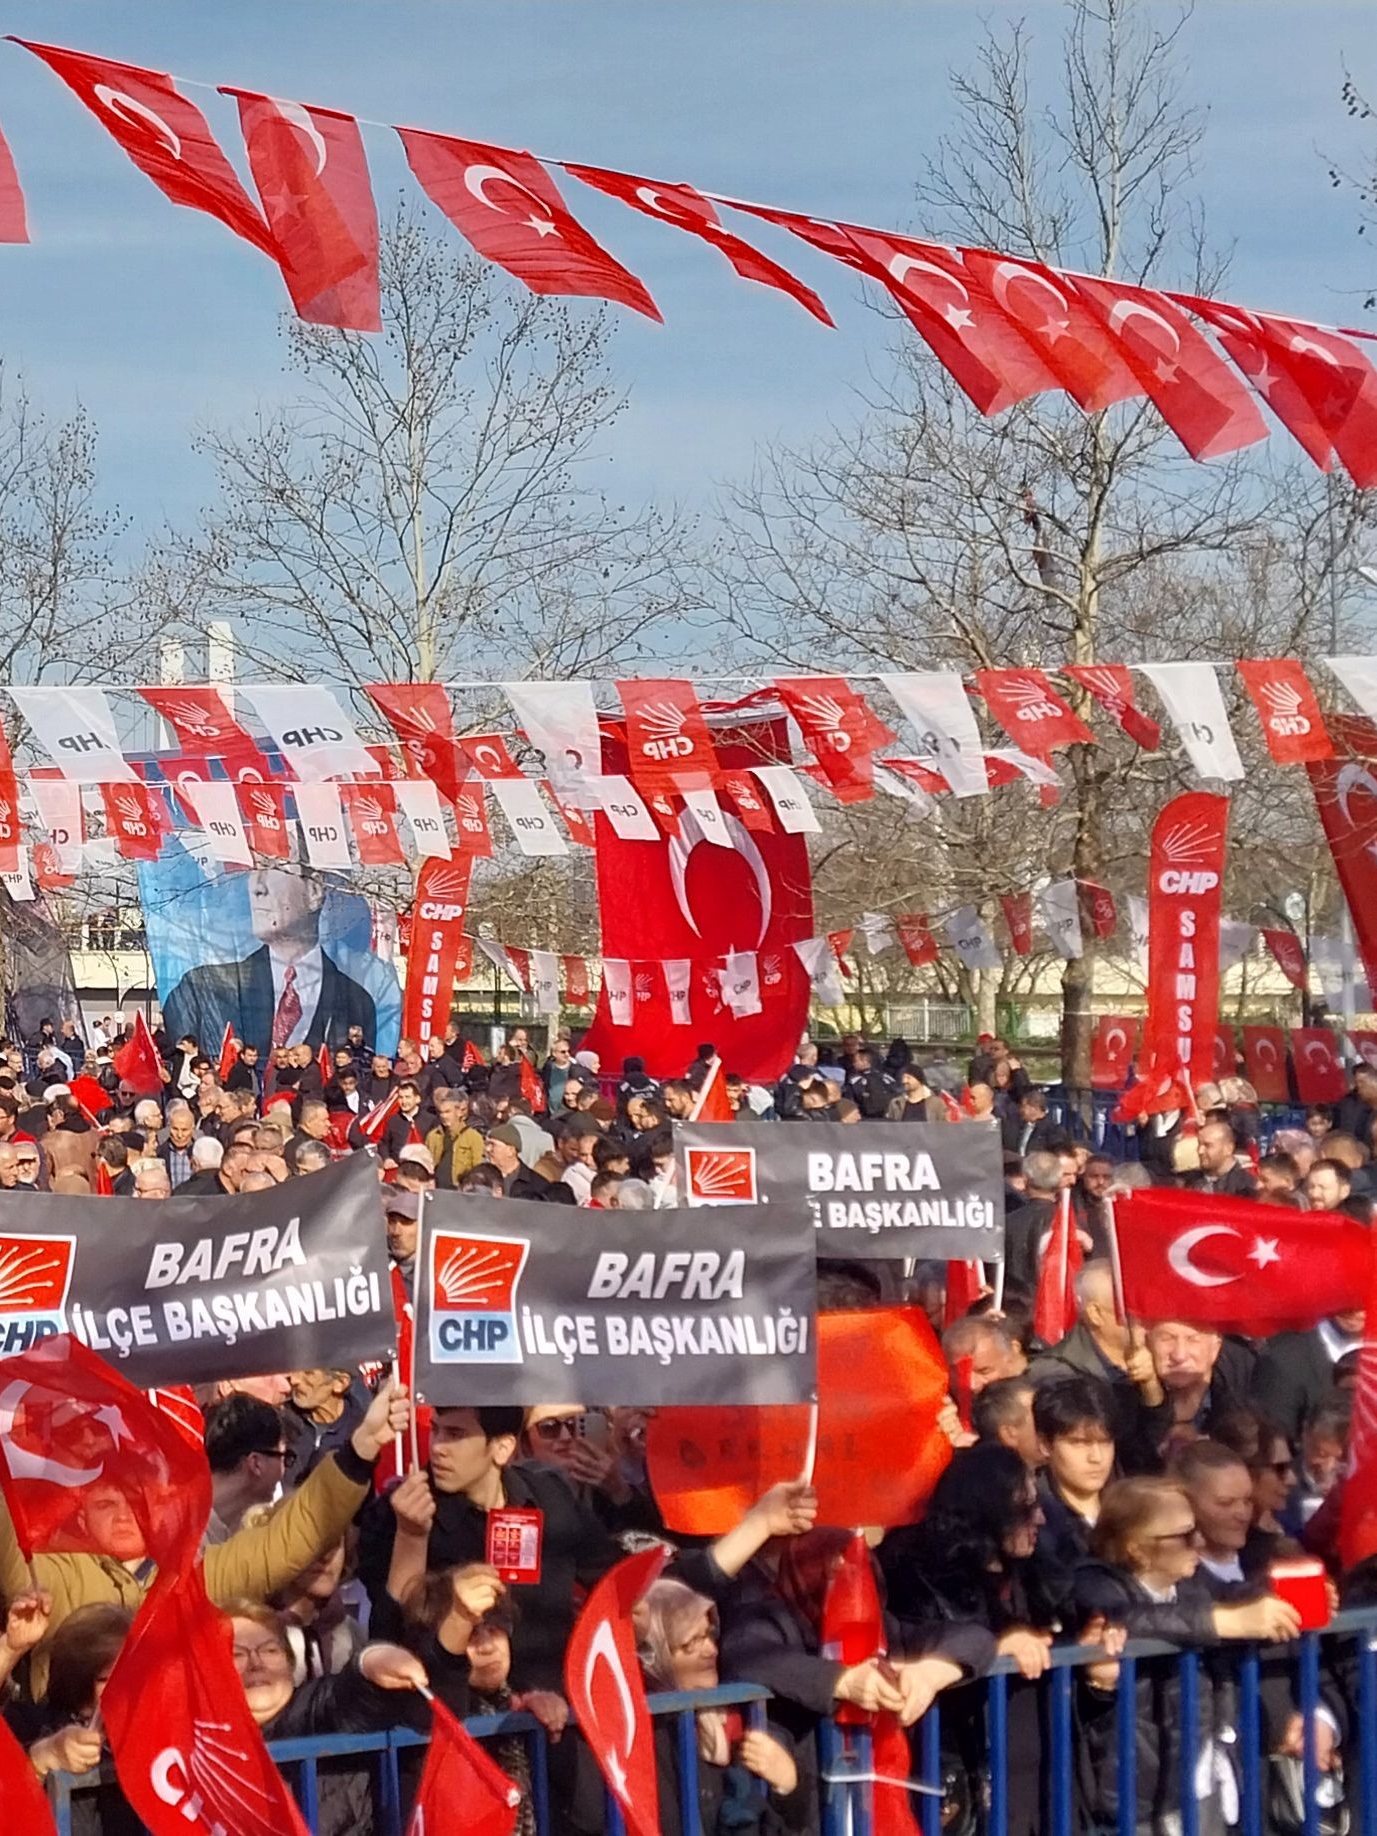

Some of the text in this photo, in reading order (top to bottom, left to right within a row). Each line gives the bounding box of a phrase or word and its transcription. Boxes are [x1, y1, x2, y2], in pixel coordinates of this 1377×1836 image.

[1159, 871, 1219, 896] CHP
[419, 902, 464, 921] CHP
[807, 1153, 942, 1193] BAFRA
[829, 1195, 995, 1235] BAŞKANLIĞI
[144, 1218, 308, 1291] BAFRA
[587, 1251, 747, 1299] BAFRA
[71, 1267, 381, 1359] İLÇE BAŞKANLIĞI
[438, 1317, 510, 1351] CHP
[523, 1305, 809, 1364] İLÇE BAŞKANLIĞI
